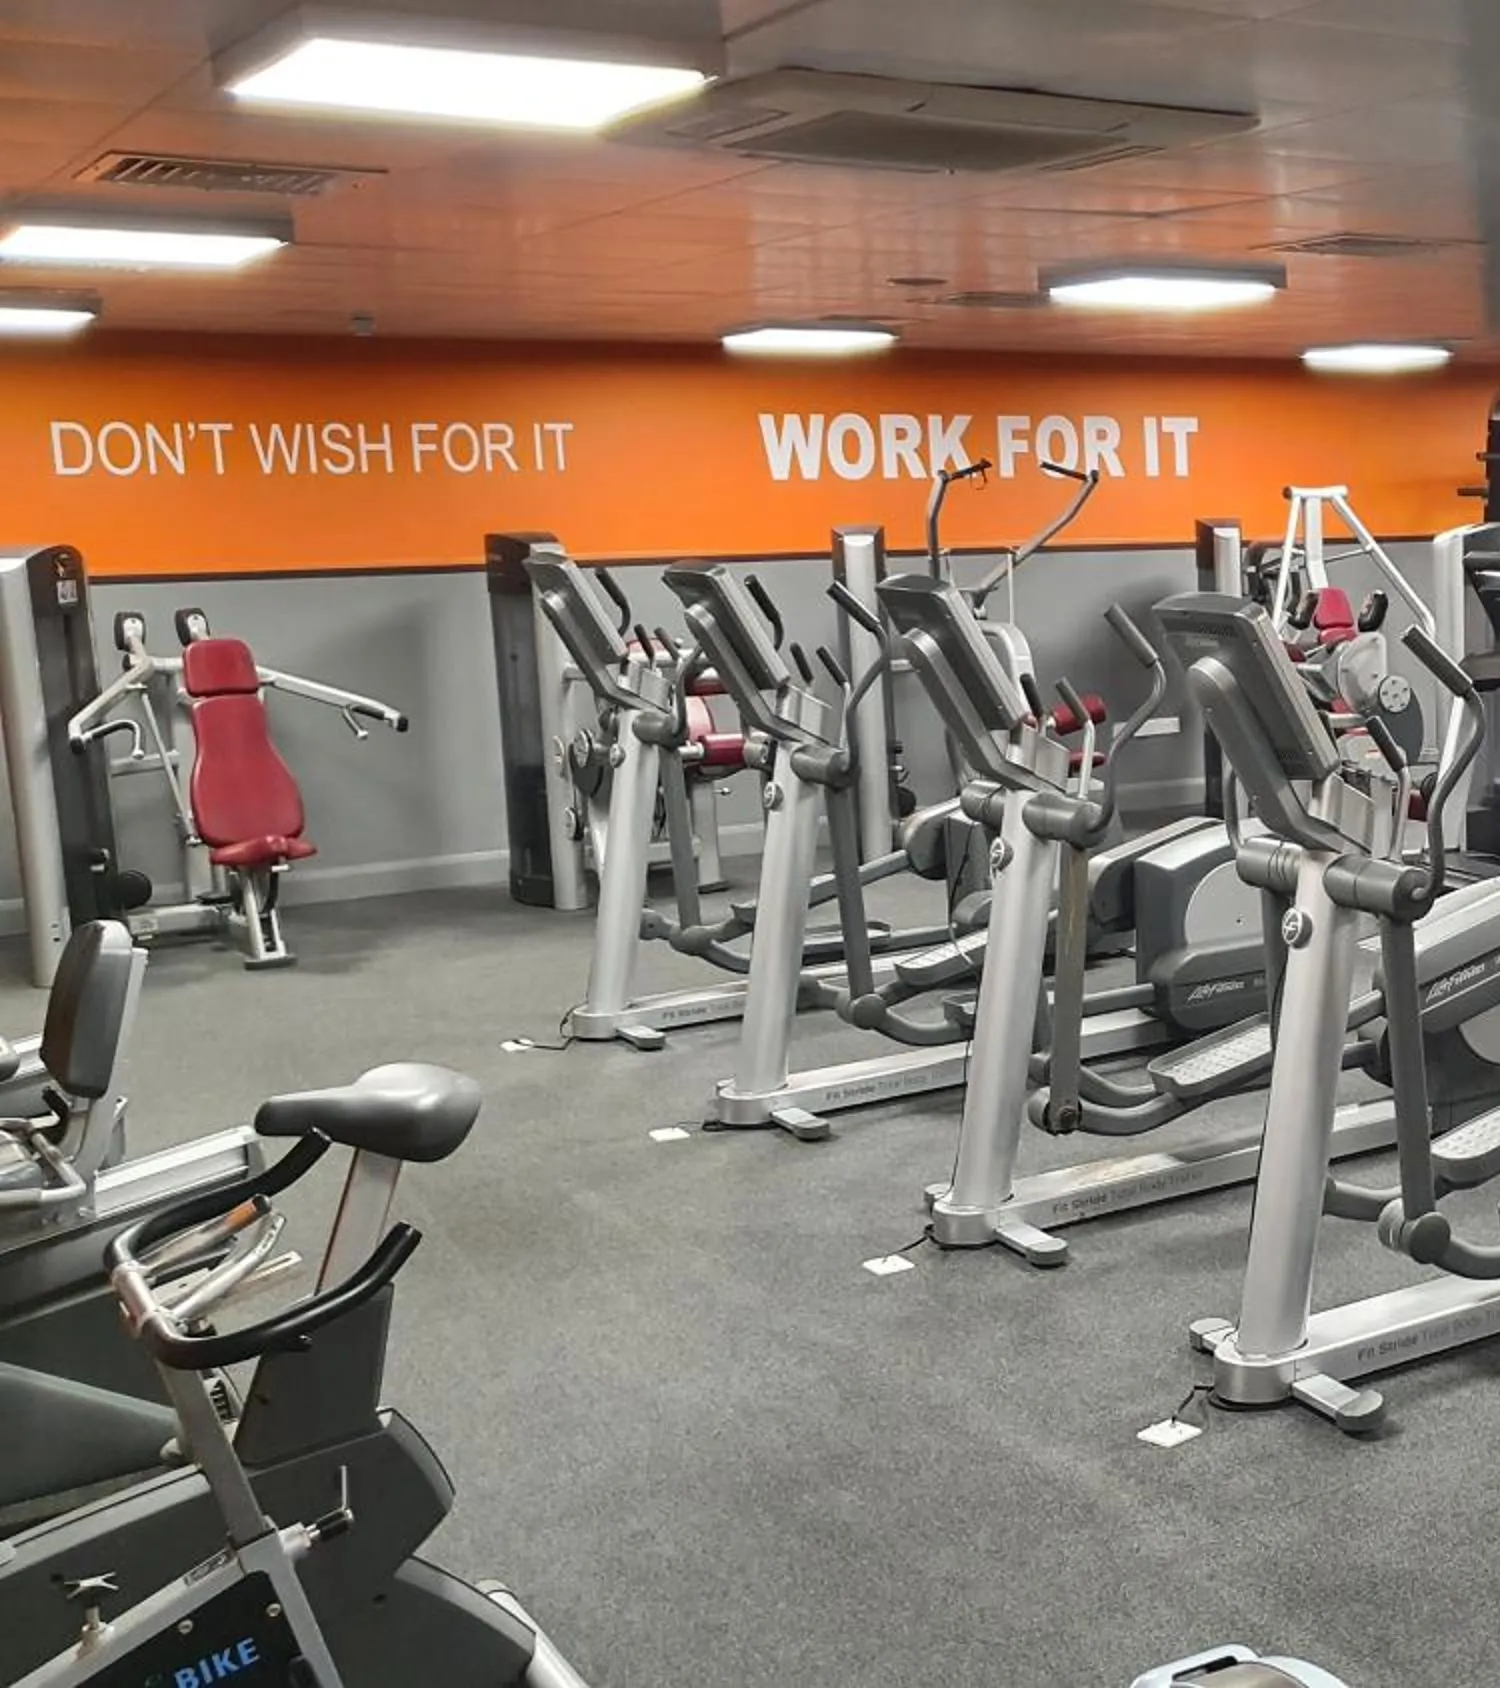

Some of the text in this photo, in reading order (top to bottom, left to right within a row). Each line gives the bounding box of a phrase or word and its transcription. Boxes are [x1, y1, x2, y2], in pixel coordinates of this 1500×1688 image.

[50, 421, 575, 476] DON'T WISH FOR IT
[758, 413, 1199, 481] WORK FOR IT
[174, 1636, 261, 1688] BIKE
